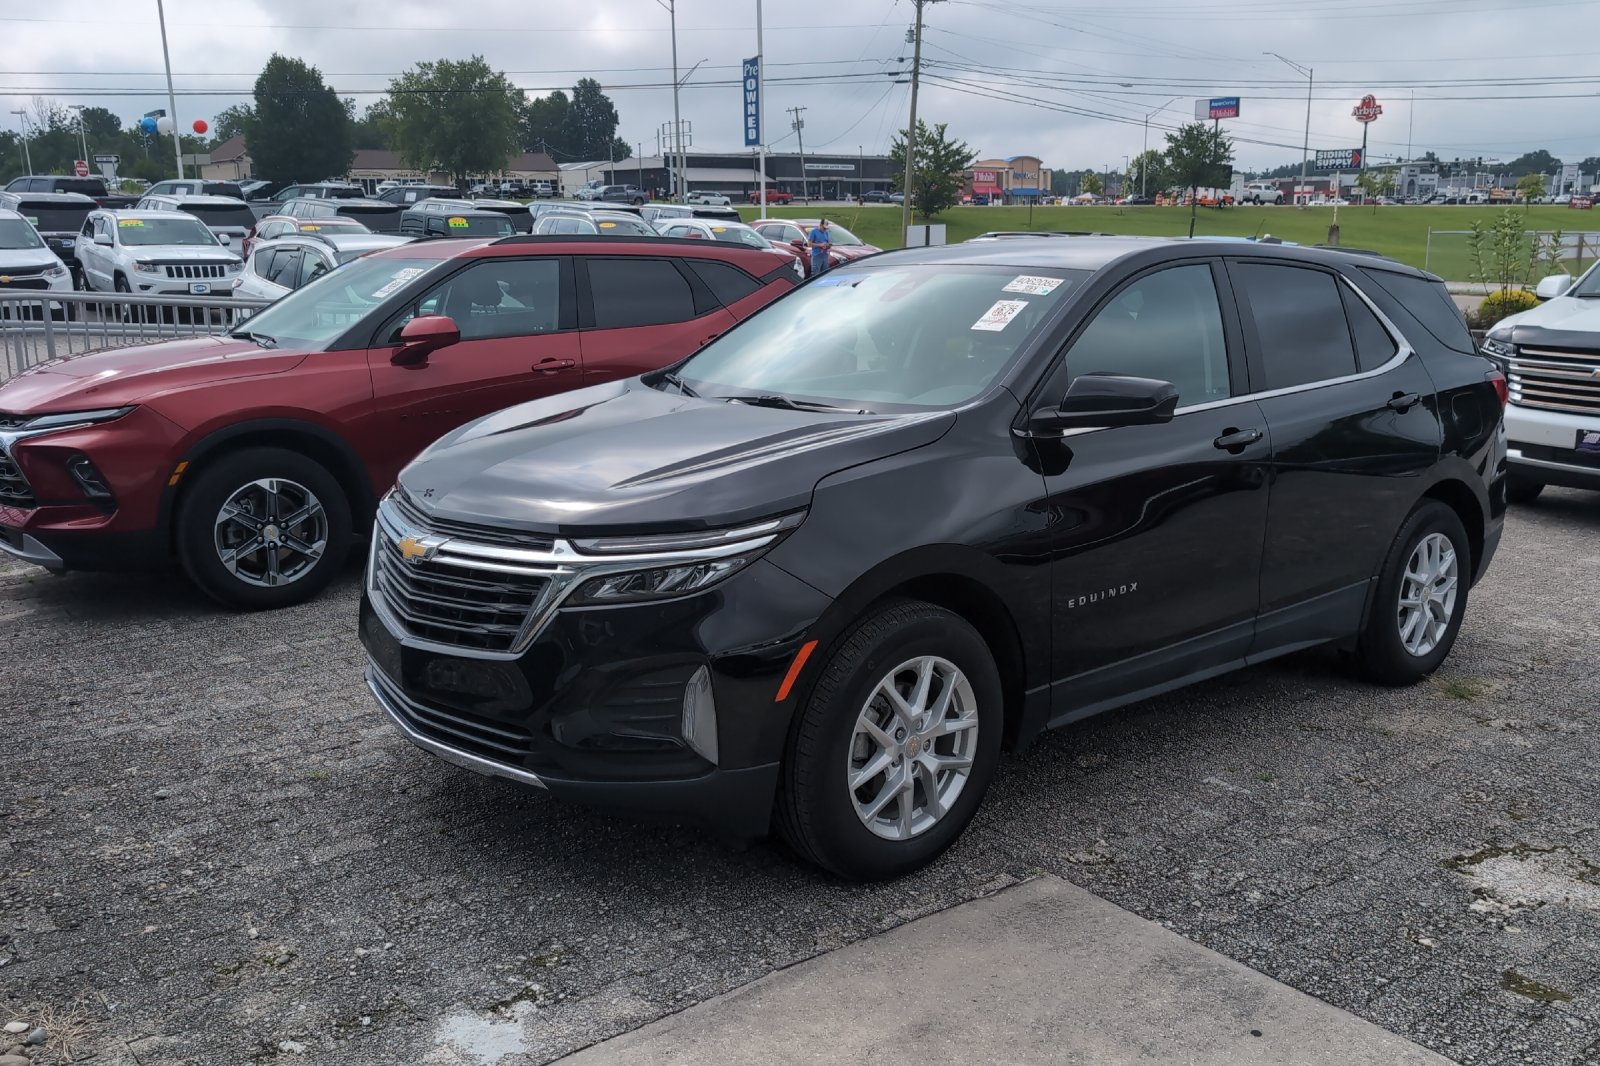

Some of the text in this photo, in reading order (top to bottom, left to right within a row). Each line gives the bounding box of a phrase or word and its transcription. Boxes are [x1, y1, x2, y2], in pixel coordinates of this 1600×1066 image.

[744, 64, 758, 77] Pre
[746, 79, 757, 139] OWNED
[1352, 105, 1382, 116] Arby's
[1316, 150, 1353, 159] SIDING
[1316, 158, 1352, 167] SUPPLY
[1068, 581, 1138, 608] EQUINOX
